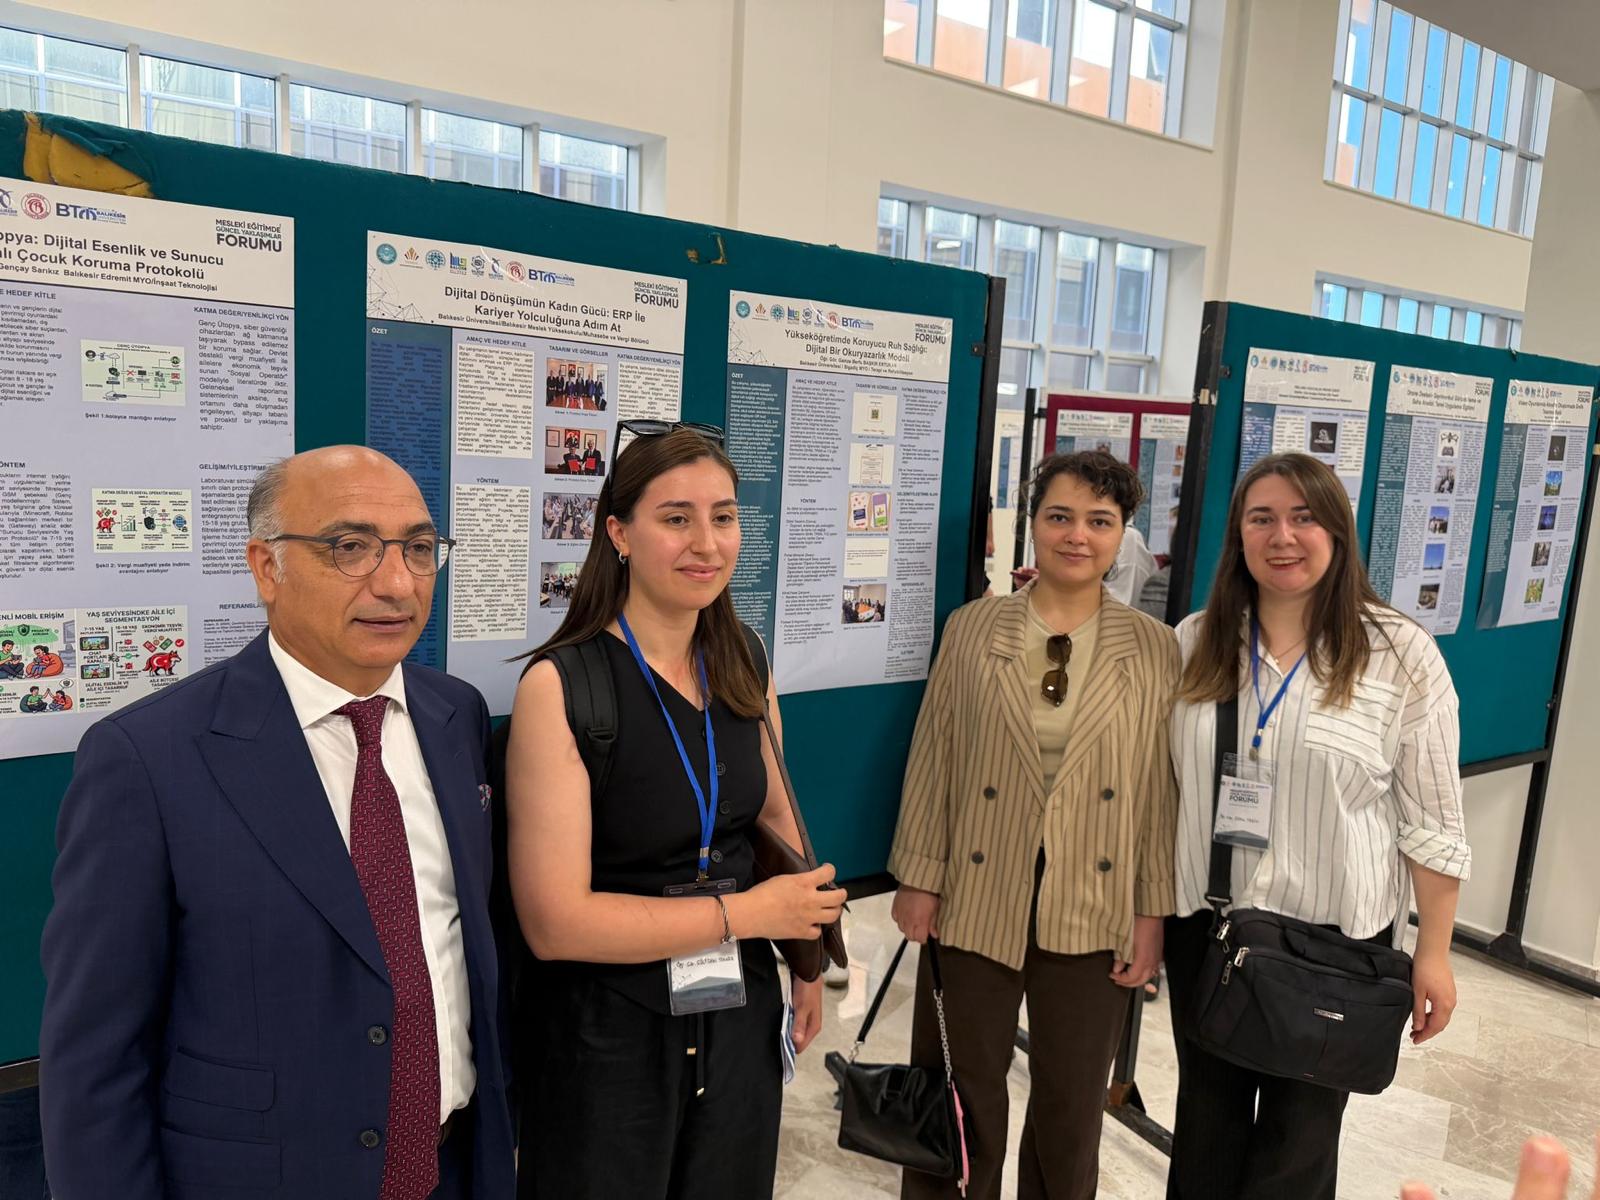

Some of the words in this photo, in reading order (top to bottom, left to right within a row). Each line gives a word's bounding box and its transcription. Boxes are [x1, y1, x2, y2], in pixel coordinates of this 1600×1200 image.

[215, 218, 246, 229] MESLEKİ
[247, 222, 281, 234] EĞİTİMDE
[216, 226, 241, 235] GÜNCEL
[242, 229, 282, 240] YAKLAŞIMLAR
[216, 232, 282, 252] FORUMU
[44, 234, 87, 250] Dijital
[92, 240, 146, 257] Esenlik
[150, 250, 167, 259] ve
[171, 249, 224, 266] Sunucu
[0, 247, 12, 259] lı
[17, 248, 67, 265] Çocuk
[72, 255, 130, 272] Koruma
[136, 262, 204, 280] Protokolü
[32, 266, 59, 275] Sarıkız
[64, 269, 100, 279] Balıkesir
[100, 274, 132, 282] Edremit
[133, 276, 177, 288] MYO/İnşaat
[178, 282, 218, 292] Teknolojisi
[34, 291, 56, 300] KİTLE
[635, 293, 679, 308] FORUMU
[445, 286, 477, 300] Dijital
[480, 290, 545, 308] Dönüşümün
[548, 300, 578, 313] Kadın
[580, 304, 610, 318] Gücü:
[613, 309, 632, 320] ERP
[635, 311, 646, 322] İle
[194, 306, 217, 314] KATMA
[218, 308, 275, 320] DEĞER/YENİLİKÇİ
[475, 305, 514, 319] Kariyer
[517, 310, 580, 327] Yolculuğuna
[583, 320, 608, 331] Adım
[610, 323, 621, 333] At
[438, 313, 464, 321] Balıkesir
[528, 324, 547, 332] Meslek
[199, 328, 236, 336] cihazlardan
[257, 333, 288, 341] katmanına
[371, 327, 388, 335] ÖZET
[198, 336, 228, 344] taşıyarak
[785, 329, 851, 344] Yükseköğretimde
[852, 337, 886, 349] Koruyucu
[888, 341, 902, 350] Ruh
[915, 333, 946, 345] FORUMU
[549, 345, 571, 353] TASARIM
[580, 348, 608, 357] GÖRSELLER
[806, 344, 827, 355] Dijital
[830, 347, 840, 355] Bir
[842, 348, 886, 359] Okuryazarlık
[888, 352, 910, 362] Modeli
[15, 612, 38, 620] MOBİL
[40, 612, 64, 620] ERİŞİM
